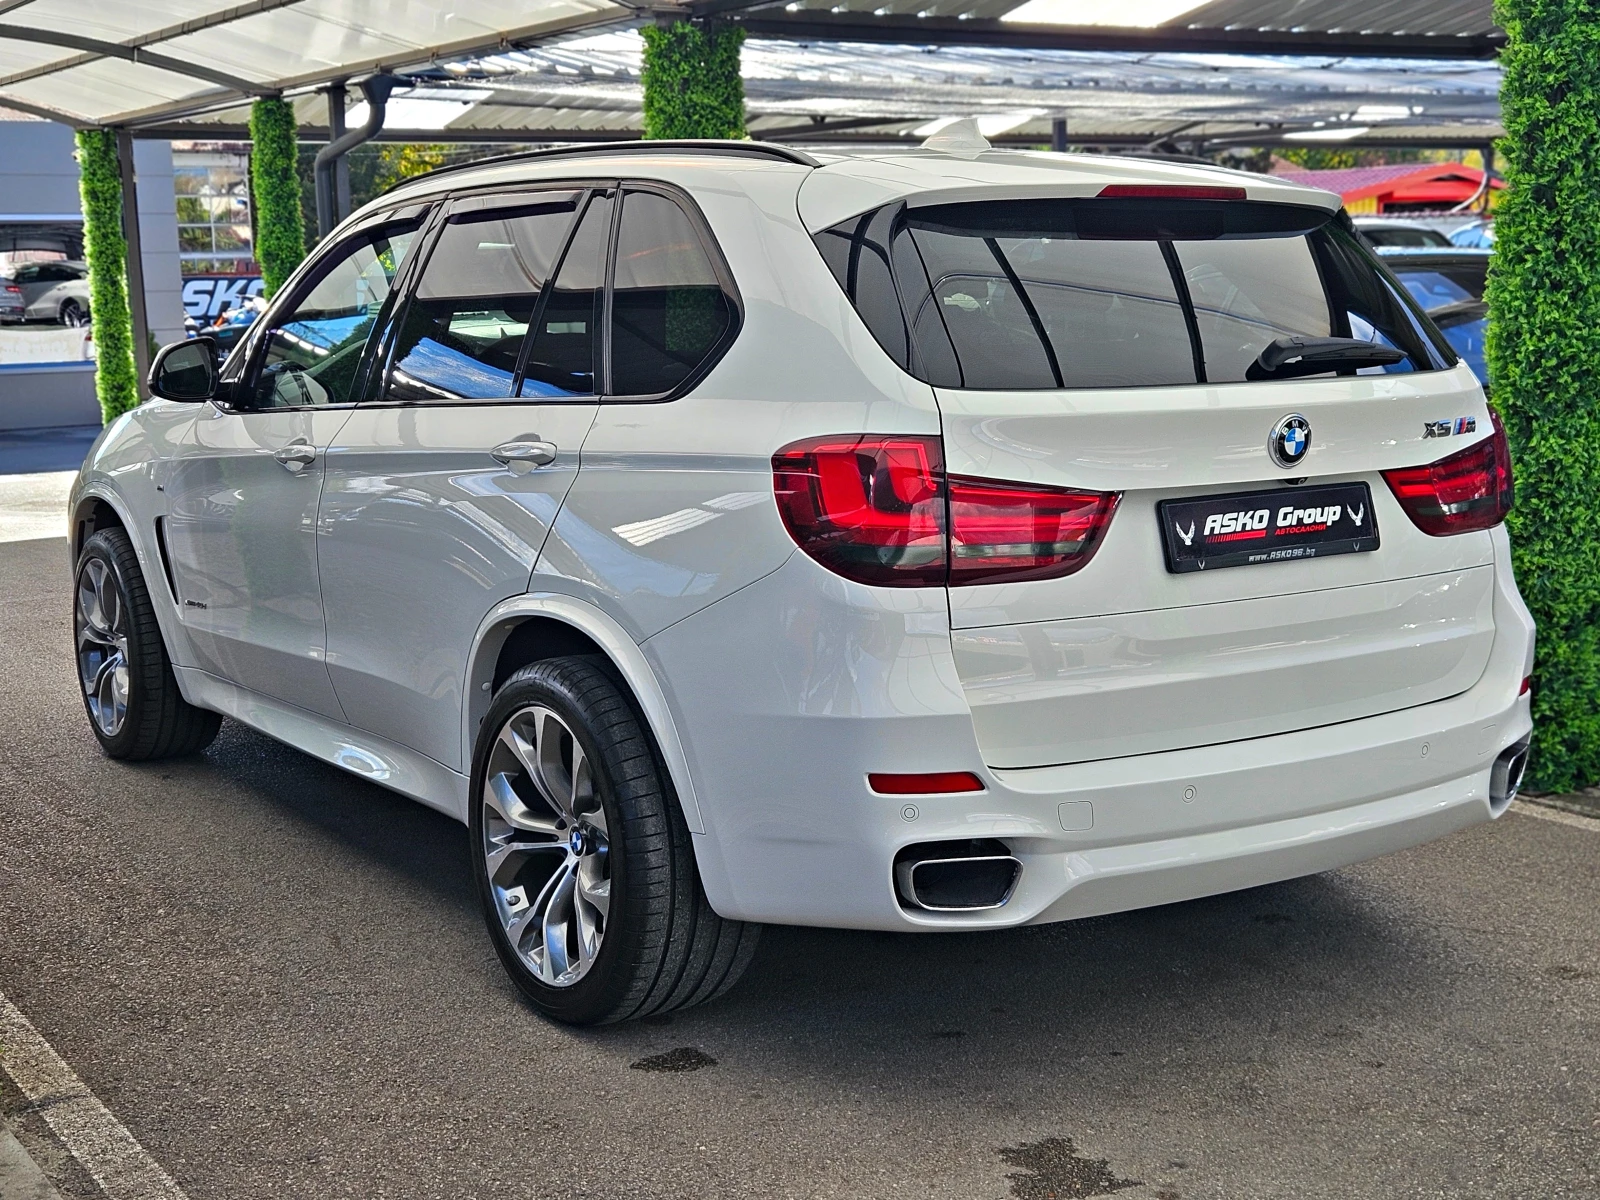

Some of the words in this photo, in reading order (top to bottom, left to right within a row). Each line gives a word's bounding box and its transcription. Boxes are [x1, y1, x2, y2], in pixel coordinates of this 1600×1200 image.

[1203, 509, 1269, 535] ASKO
[1277, 505, 1341, 527] Group
[1274, 524, 1327, 536] АВТОСАЛОНИ
